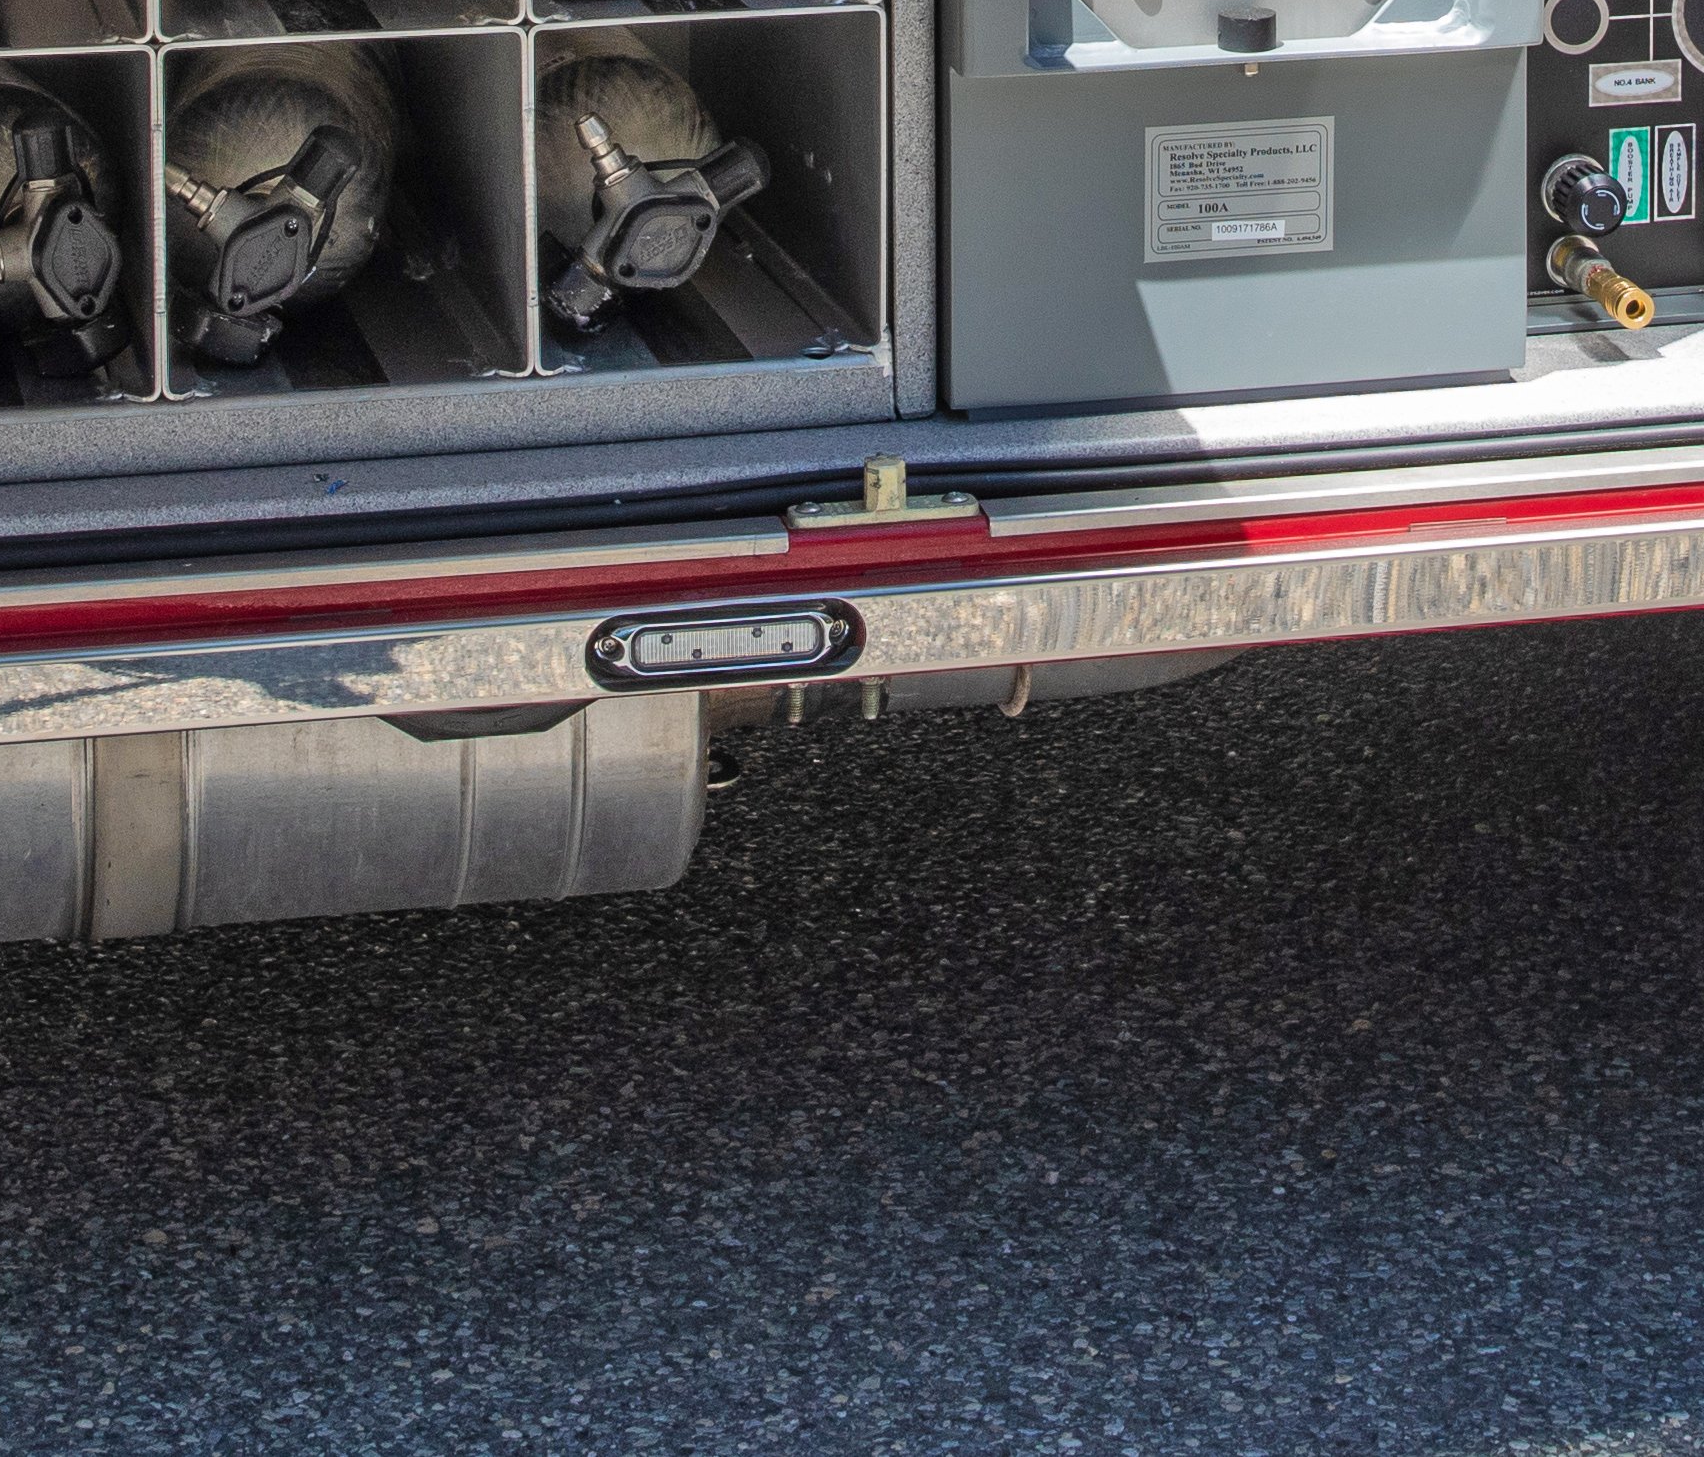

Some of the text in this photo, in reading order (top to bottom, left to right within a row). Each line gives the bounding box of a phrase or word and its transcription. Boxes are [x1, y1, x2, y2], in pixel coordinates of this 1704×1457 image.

[1613, 77, 1656, 87] NO.4 BANK
[1170, 143, 1318, 161] Resolve Specialty Products, LLC
[1198, 203, 1230, 214] 100A
[1216, 223, 1278, 234] 1009171786A
